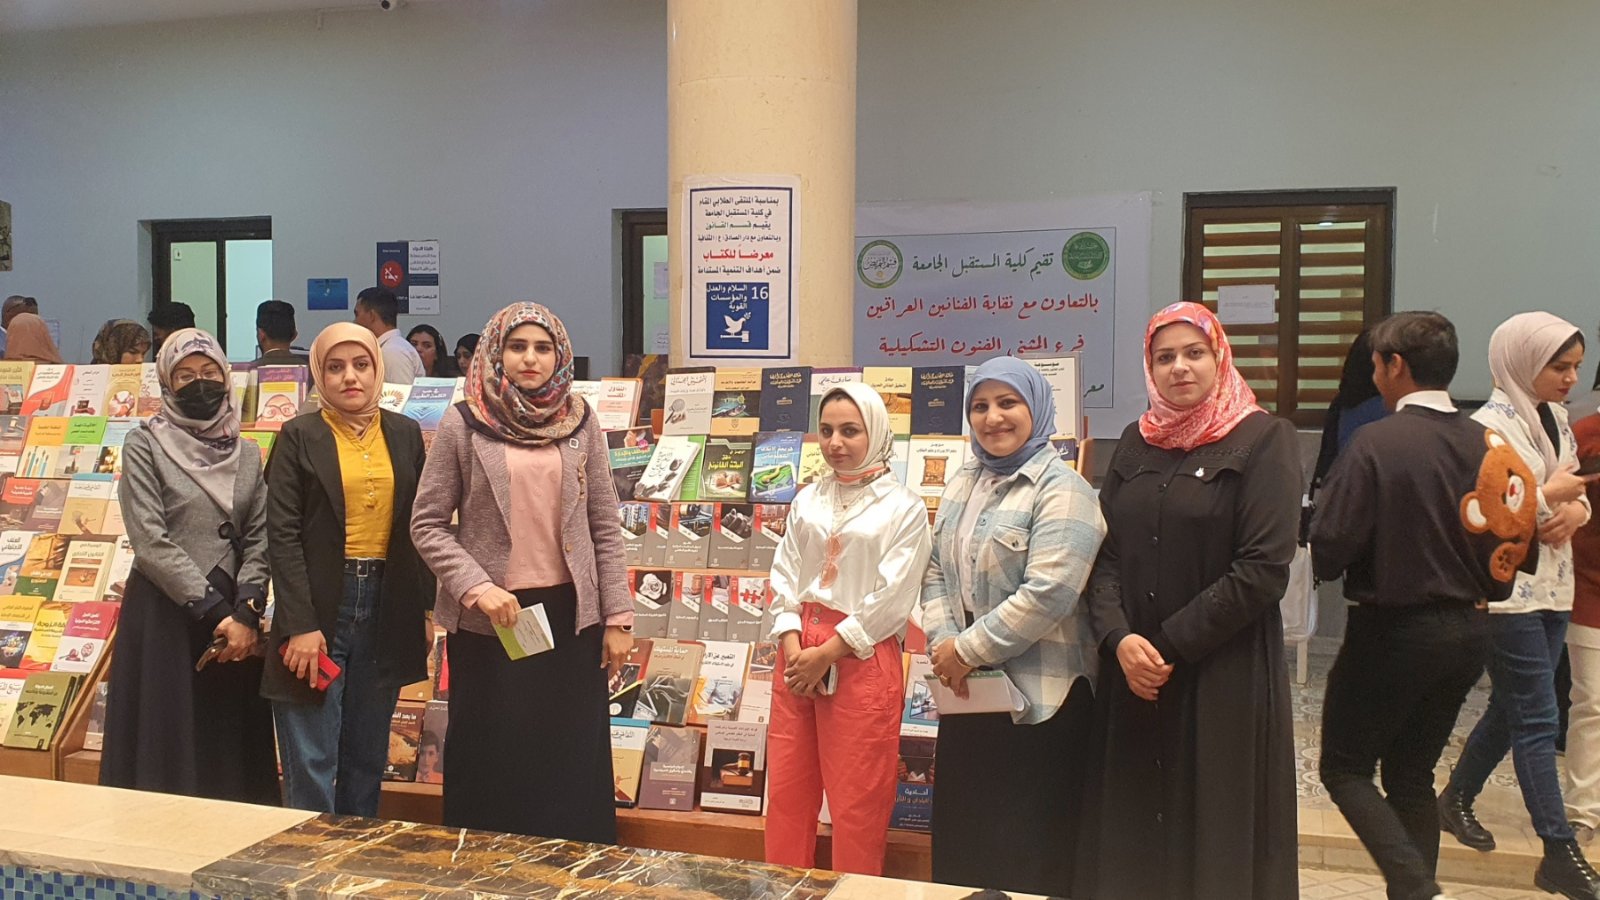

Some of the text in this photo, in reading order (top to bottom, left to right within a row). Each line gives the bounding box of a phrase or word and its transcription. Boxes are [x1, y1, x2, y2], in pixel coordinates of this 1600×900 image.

[713, 197, 733, 207] الطلابي
[735, 196, 753, 205] الملتقى
[755, 195, 779, 206] بمناسبة
[705, 208, 772, 219] في كلية المستقبل الجامعة
[912, 247, 1054, 281] تقيم كلية المستقبل الجامعة
[723, 265, 745, 275] التنمية
[766, 266, 781, 275] ضمن
[707, 284, 748, 293] السلام والعدل
[751, 286, 769, 300] 16
[710, 294, 748, 303] والمؤسسات
[729, 302, 748, 312] القوية
[866, 293, 1099, 319] بالتعاون مع نقابة الفنانين العراقين
[879, 331, 946, 357] التشكيلية
[951, 337, 1002, 356] الفنون
[1083, 383, 1105, 398] معر
